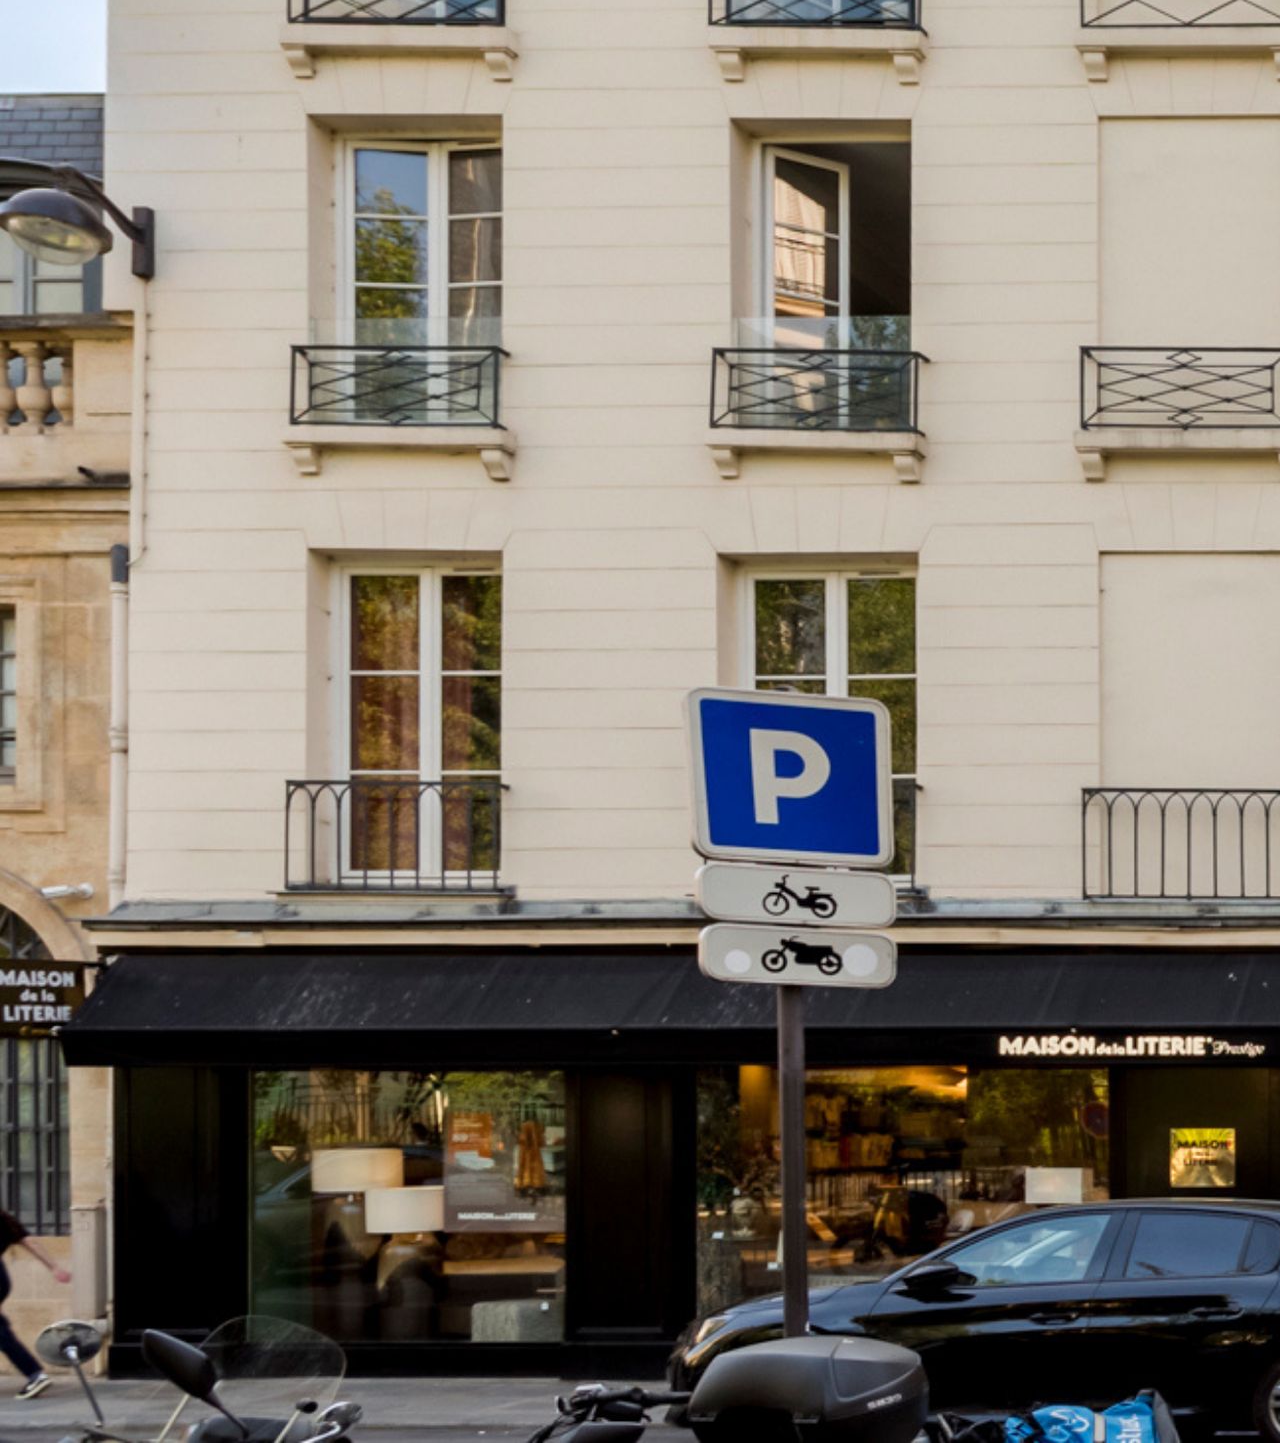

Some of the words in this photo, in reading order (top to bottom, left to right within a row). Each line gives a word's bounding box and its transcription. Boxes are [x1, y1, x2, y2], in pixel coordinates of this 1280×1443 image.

[749, 728, 831, 824] P
[0, 969, 75, 987] MAISON
[20, 989, 38, 1002] de
[41, 989, 56, 1002] la
[3, 1005, 72, 1022] LITERIE
[999, 1036, 1095, 1055] MAISON
